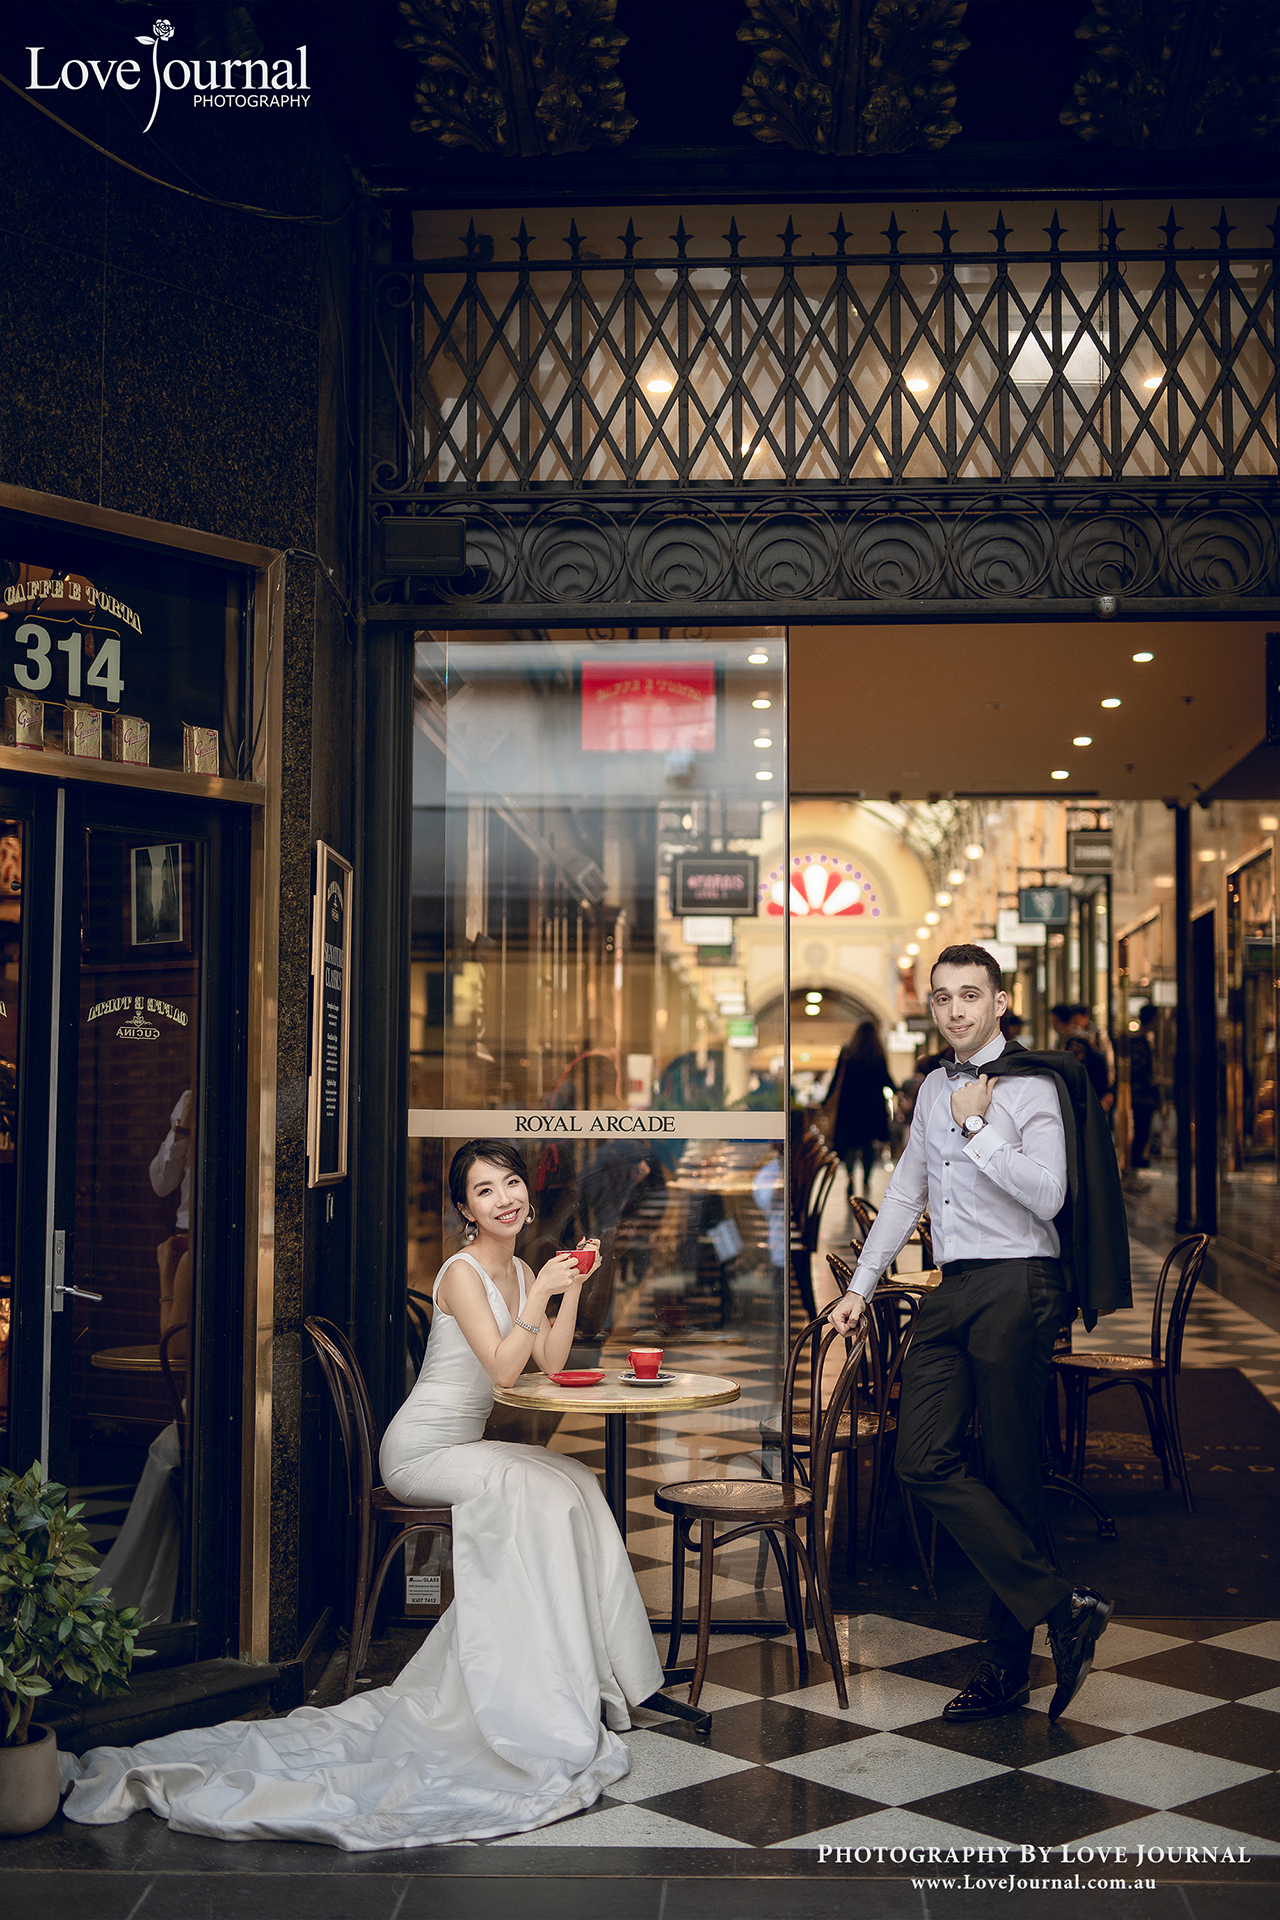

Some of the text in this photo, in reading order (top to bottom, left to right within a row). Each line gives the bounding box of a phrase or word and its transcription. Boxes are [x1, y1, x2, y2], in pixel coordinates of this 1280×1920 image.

[3, 579, 143, 635] CAFFE E TORTA
[13, 623, 125, 704] 314
[515, 1115, 676, 1132] ROYAL ARCADE
